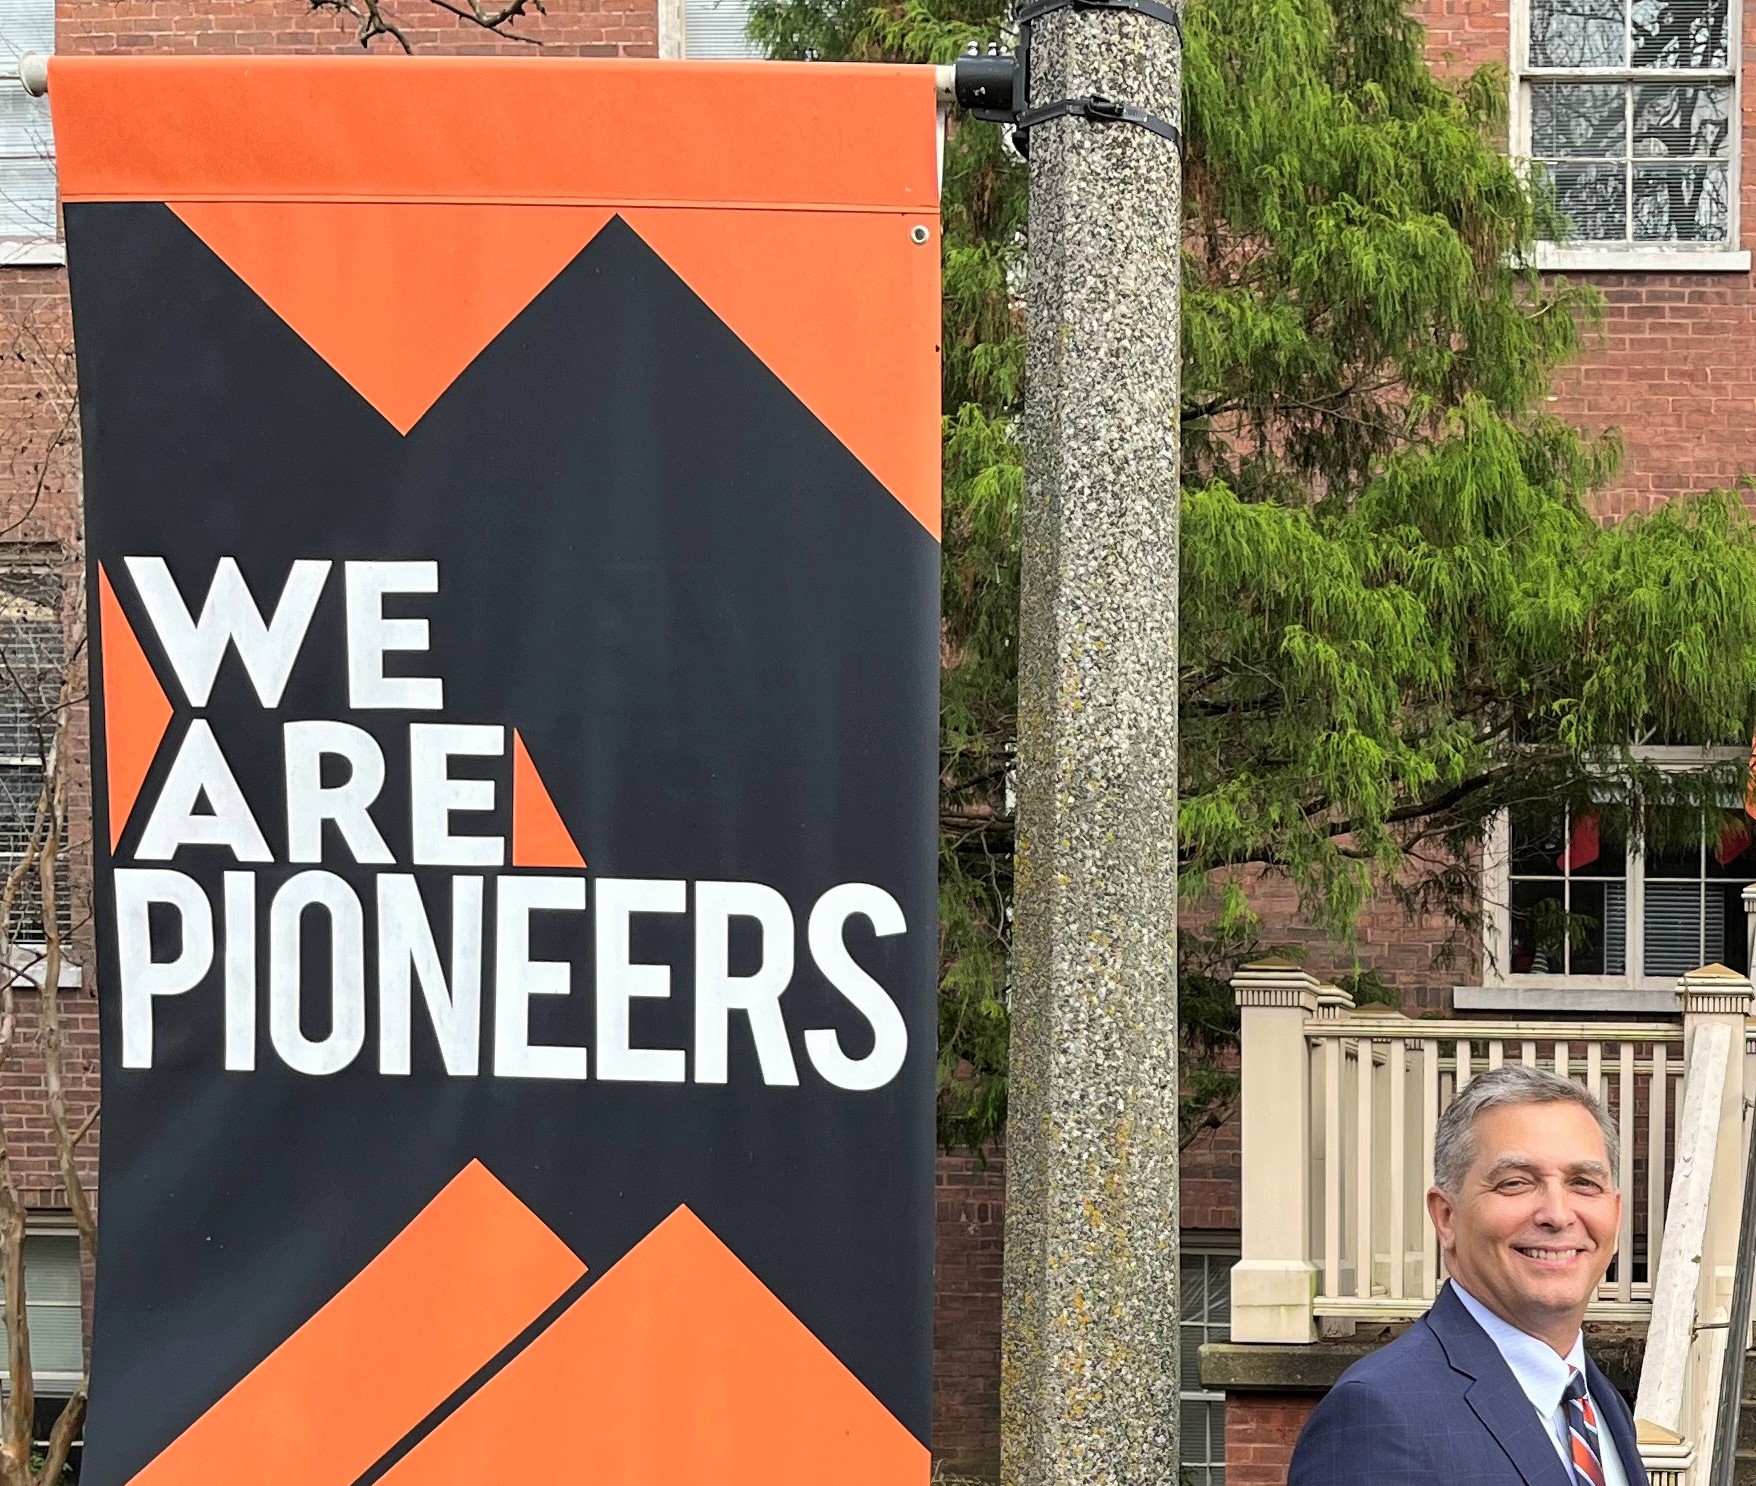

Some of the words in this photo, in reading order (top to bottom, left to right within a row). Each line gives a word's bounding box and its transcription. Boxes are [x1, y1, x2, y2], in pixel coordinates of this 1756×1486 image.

[124, 555, 444, 710] WE
[133, 718, 506, 866] ARE
[113, 867, 908, 1092] PIONEERS
